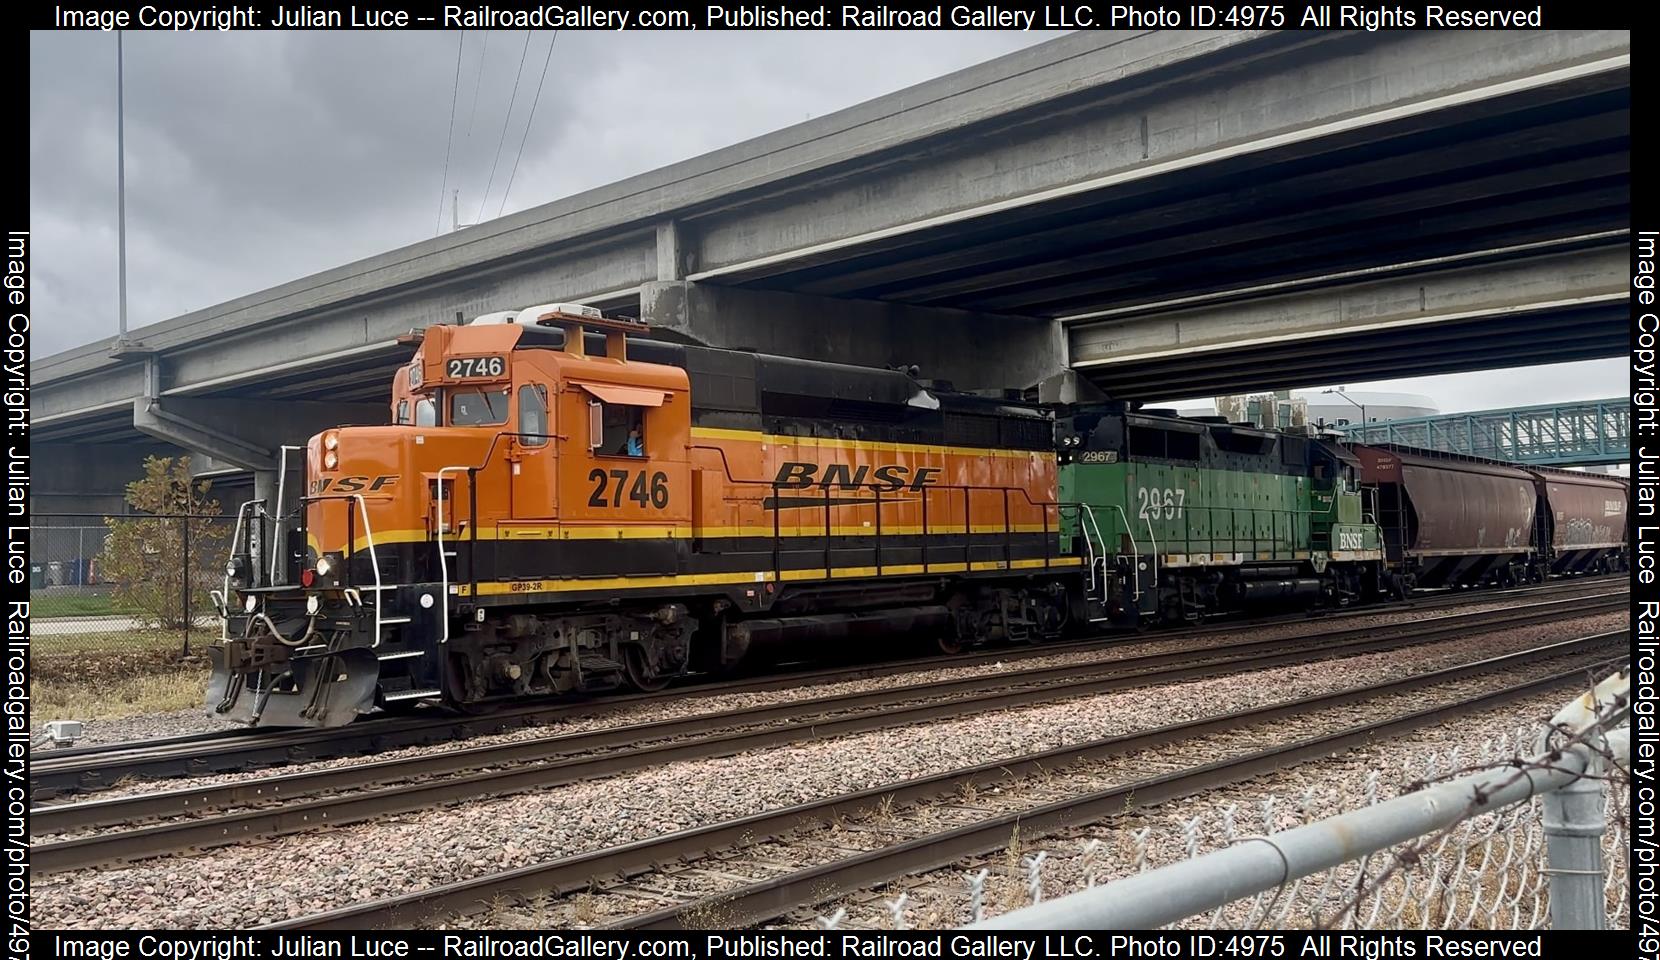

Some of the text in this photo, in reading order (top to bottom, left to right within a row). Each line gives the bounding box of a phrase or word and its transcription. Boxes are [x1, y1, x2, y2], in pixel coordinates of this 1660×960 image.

[450, 357, 502, 378] 2746
[1083, 451, 1111, 462] 2967
[310, 475, 401, 495] BNSF
[772, 461, 942, 493] BNSF
[588, 467, 669, 509] 2746
[1139, 487, 1185, 520] 2967
[1340, 532, 1363, 550] BNSF
[461, 585, 467, 594] F
[511, 582, 543, 592] GP39-2R
